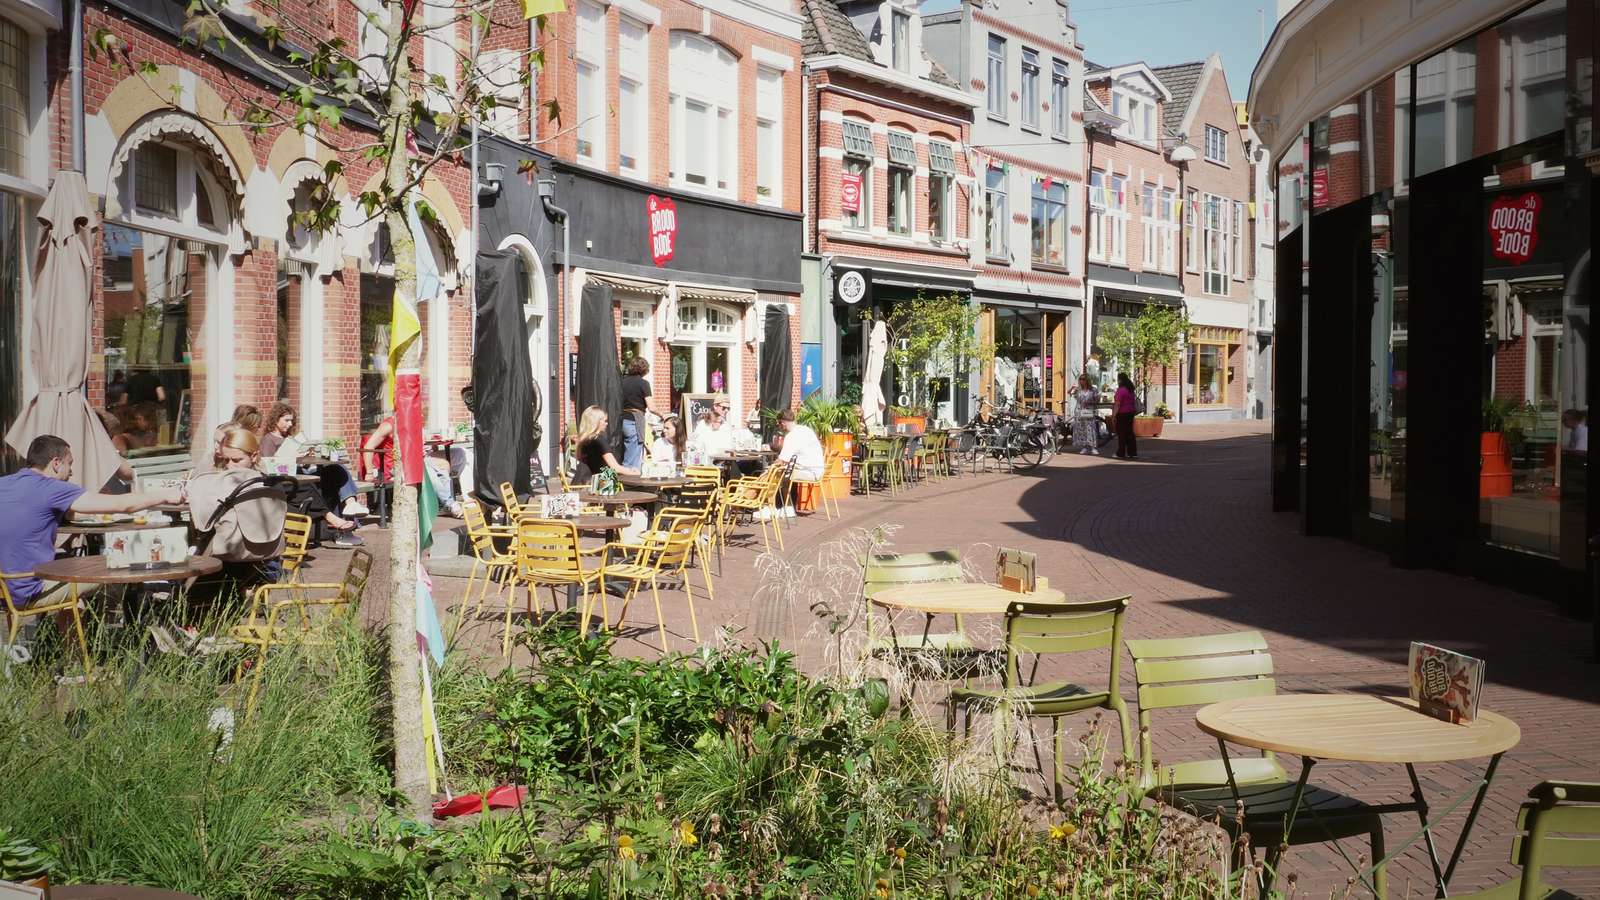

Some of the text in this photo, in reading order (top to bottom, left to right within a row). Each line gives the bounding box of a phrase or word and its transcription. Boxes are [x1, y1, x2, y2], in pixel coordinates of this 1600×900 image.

[651, 209, 675, 234] BROOD
[653, 231, 673, 258] BODE
[1426, 660, 1439, 694] BROOD
[1436, 665, 1447, 691] BODE
